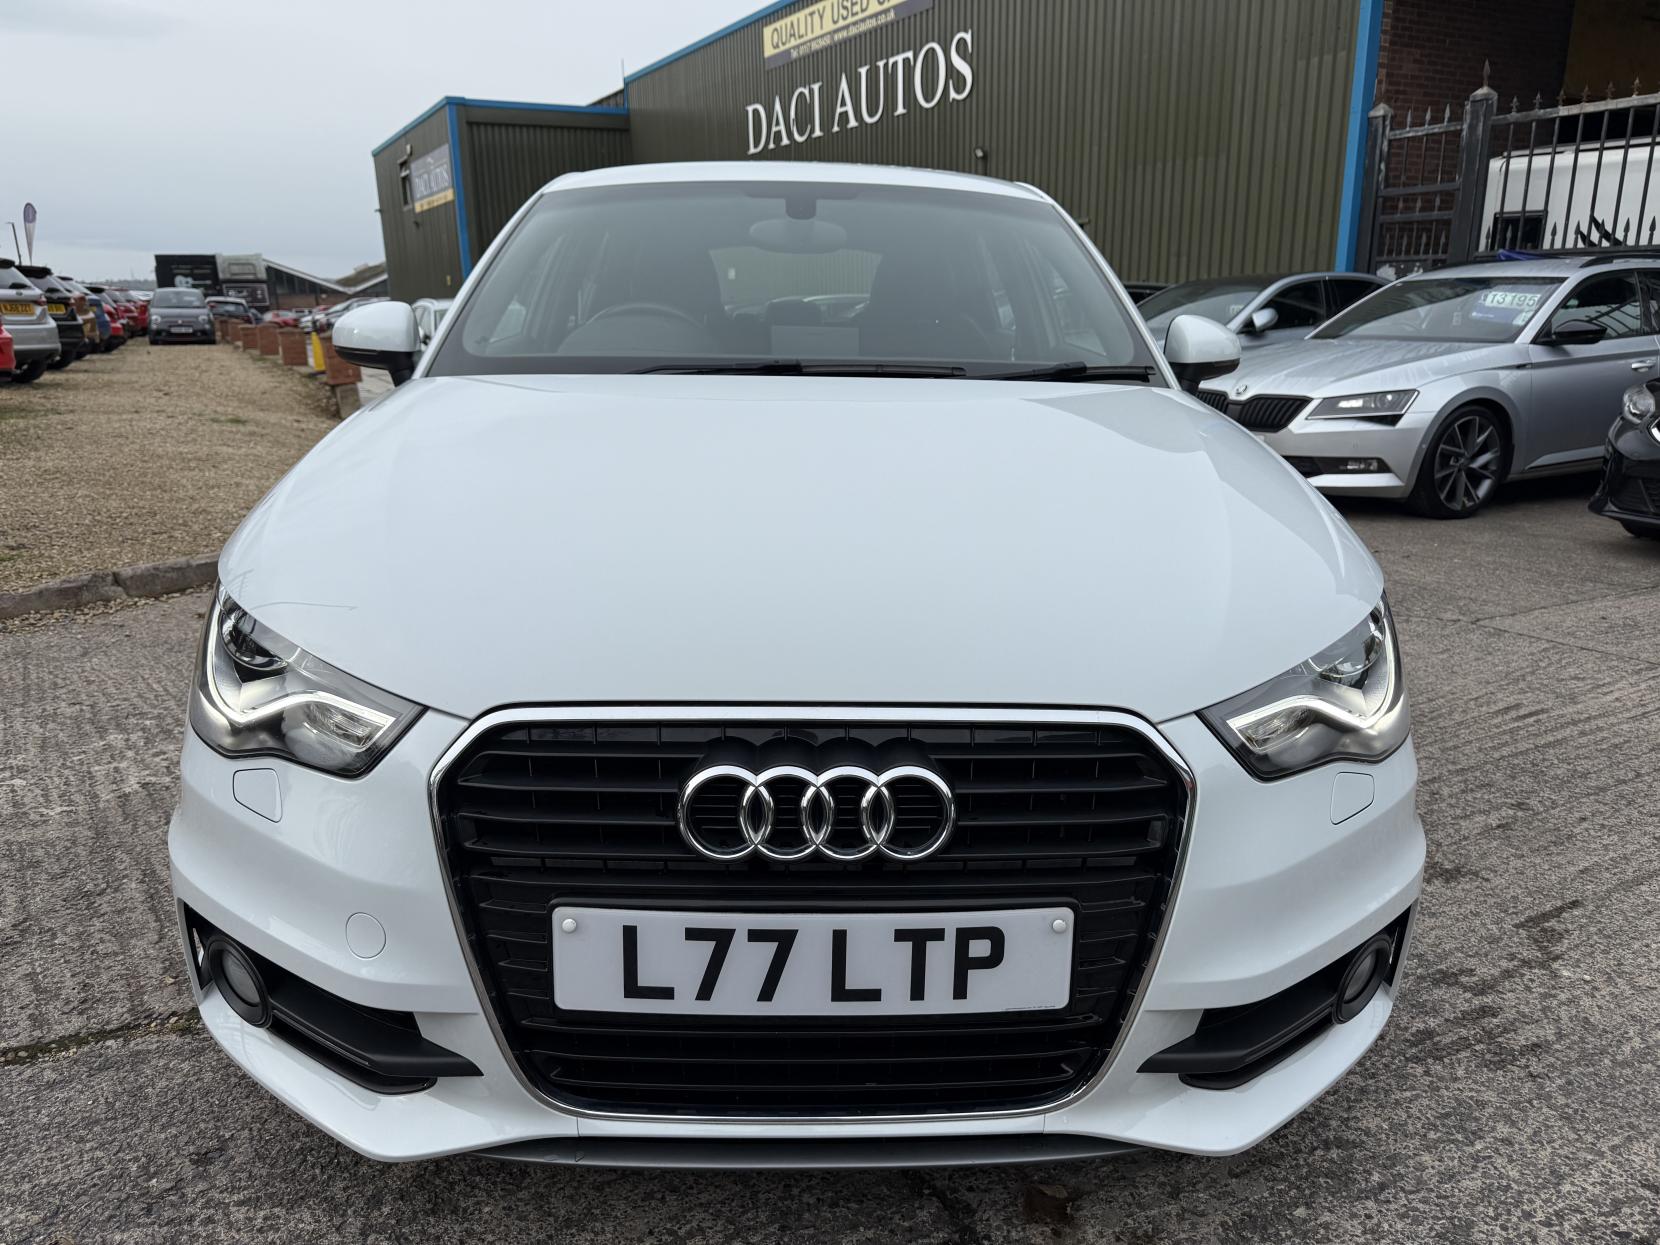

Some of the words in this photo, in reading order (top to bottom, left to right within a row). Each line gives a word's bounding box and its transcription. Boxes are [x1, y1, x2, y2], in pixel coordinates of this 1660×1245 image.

[771, 6, 826, 49] QUALITY
[831, 0, 870, 24] USED
[745, 81, 824, 155] DACI
[832, 28, 973, 133] AUTOS
[622, 924, 799, 1001] L77
[830, 926, 1005, 1001] LTP
